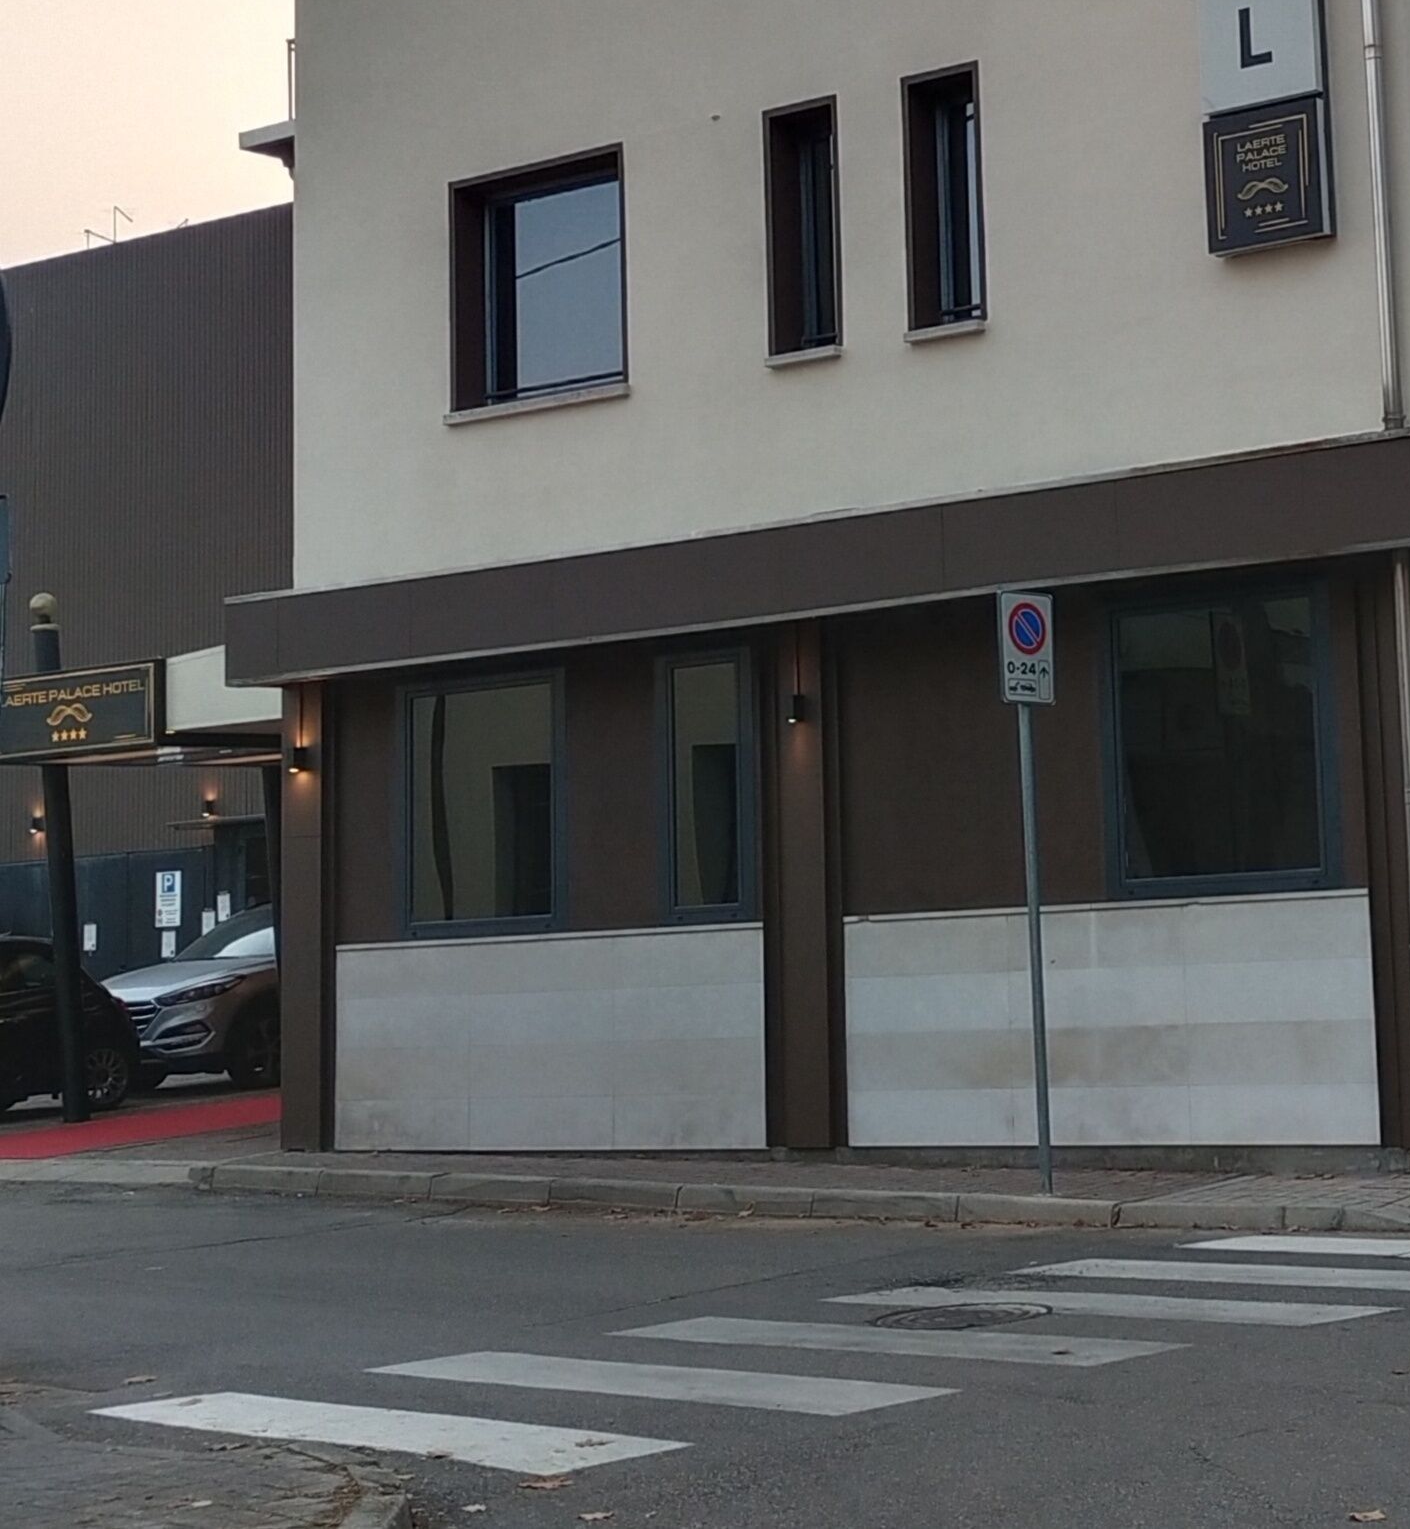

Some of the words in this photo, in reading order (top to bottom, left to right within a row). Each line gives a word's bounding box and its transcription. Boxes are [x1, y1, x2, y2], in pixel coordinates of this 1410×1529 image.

[1236, 134, 1286, 152] LAERTE
[1236, 144, 1287, 163] PALACE
[1242, 157, 1282, 172] HOTEL
[49, 684, 100, 701] PALACE
[102, 679, 145, 695] HOTEL
[164, 874, 174, 892] P
